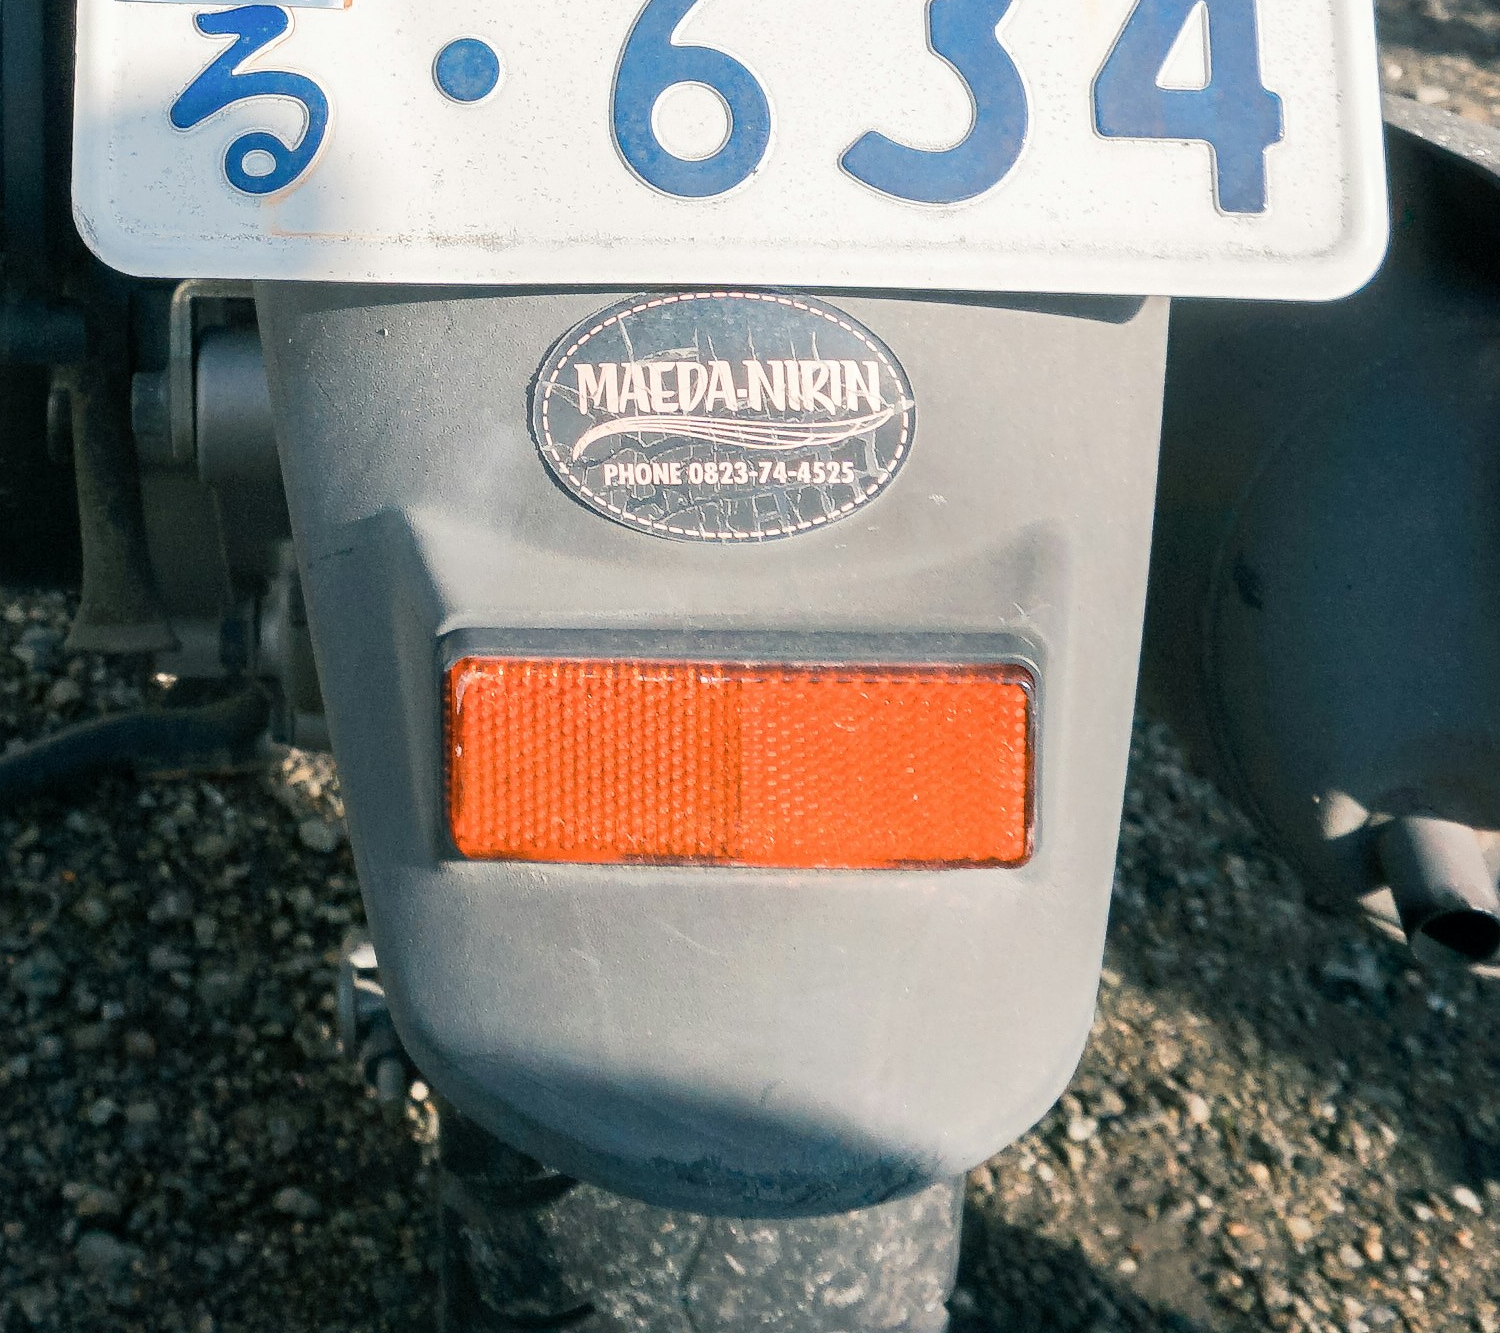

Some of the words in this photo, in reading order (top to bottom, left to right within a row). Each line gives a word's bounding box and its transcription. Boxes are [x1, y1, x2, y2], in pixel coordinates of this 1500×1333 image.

[574, 359, 882, 416] MAEDA-NIRIN
[603, 463, 684, 486] PHONE
[687, 462, 856, 486] 0823-74-4525
